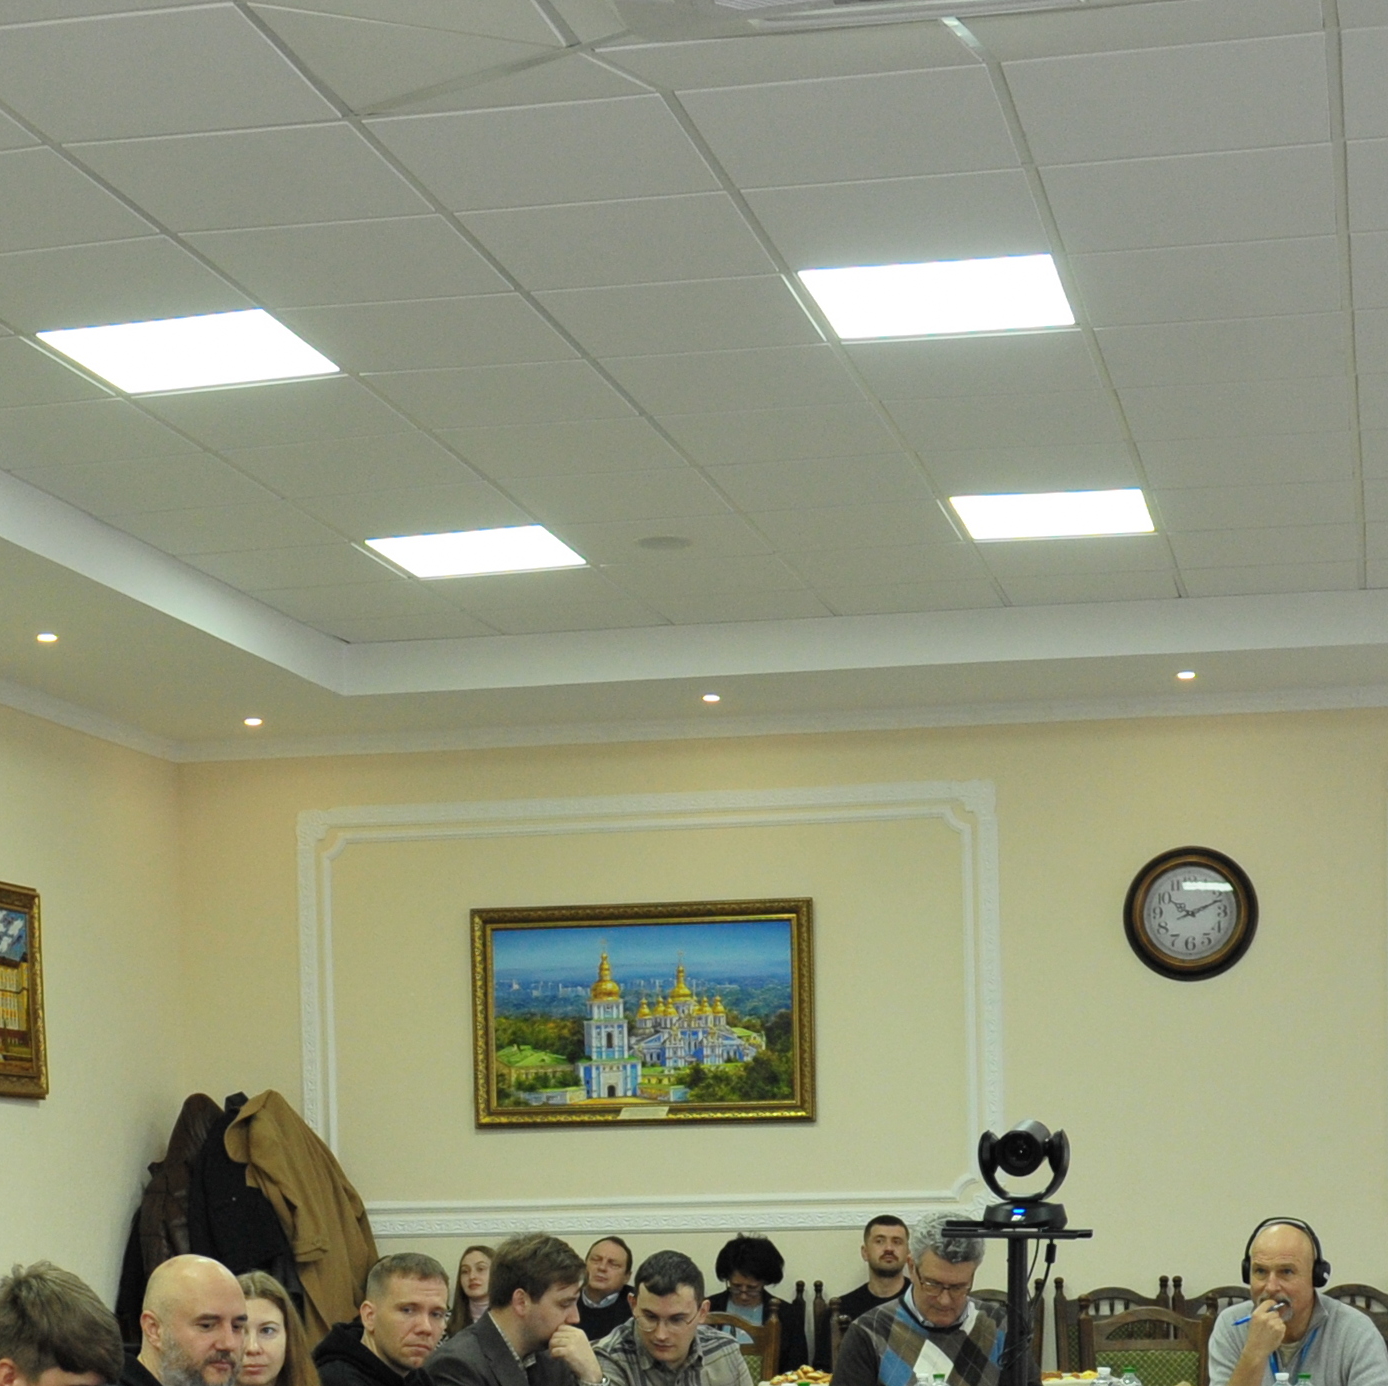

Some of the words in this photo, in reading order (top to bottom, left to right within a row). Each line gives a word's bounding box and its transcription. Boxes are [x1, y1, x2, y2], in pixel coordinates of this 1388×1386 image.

[1158, 891, 1172, 905] 10
[1217, 904, 1228, 918] 3
[1156, 921, 1169, 935] 8
[1170, 933, 1180, 948] 7
[1184, 936, 1196, 951] 6
[1201, 933, 1212, 946] 5
